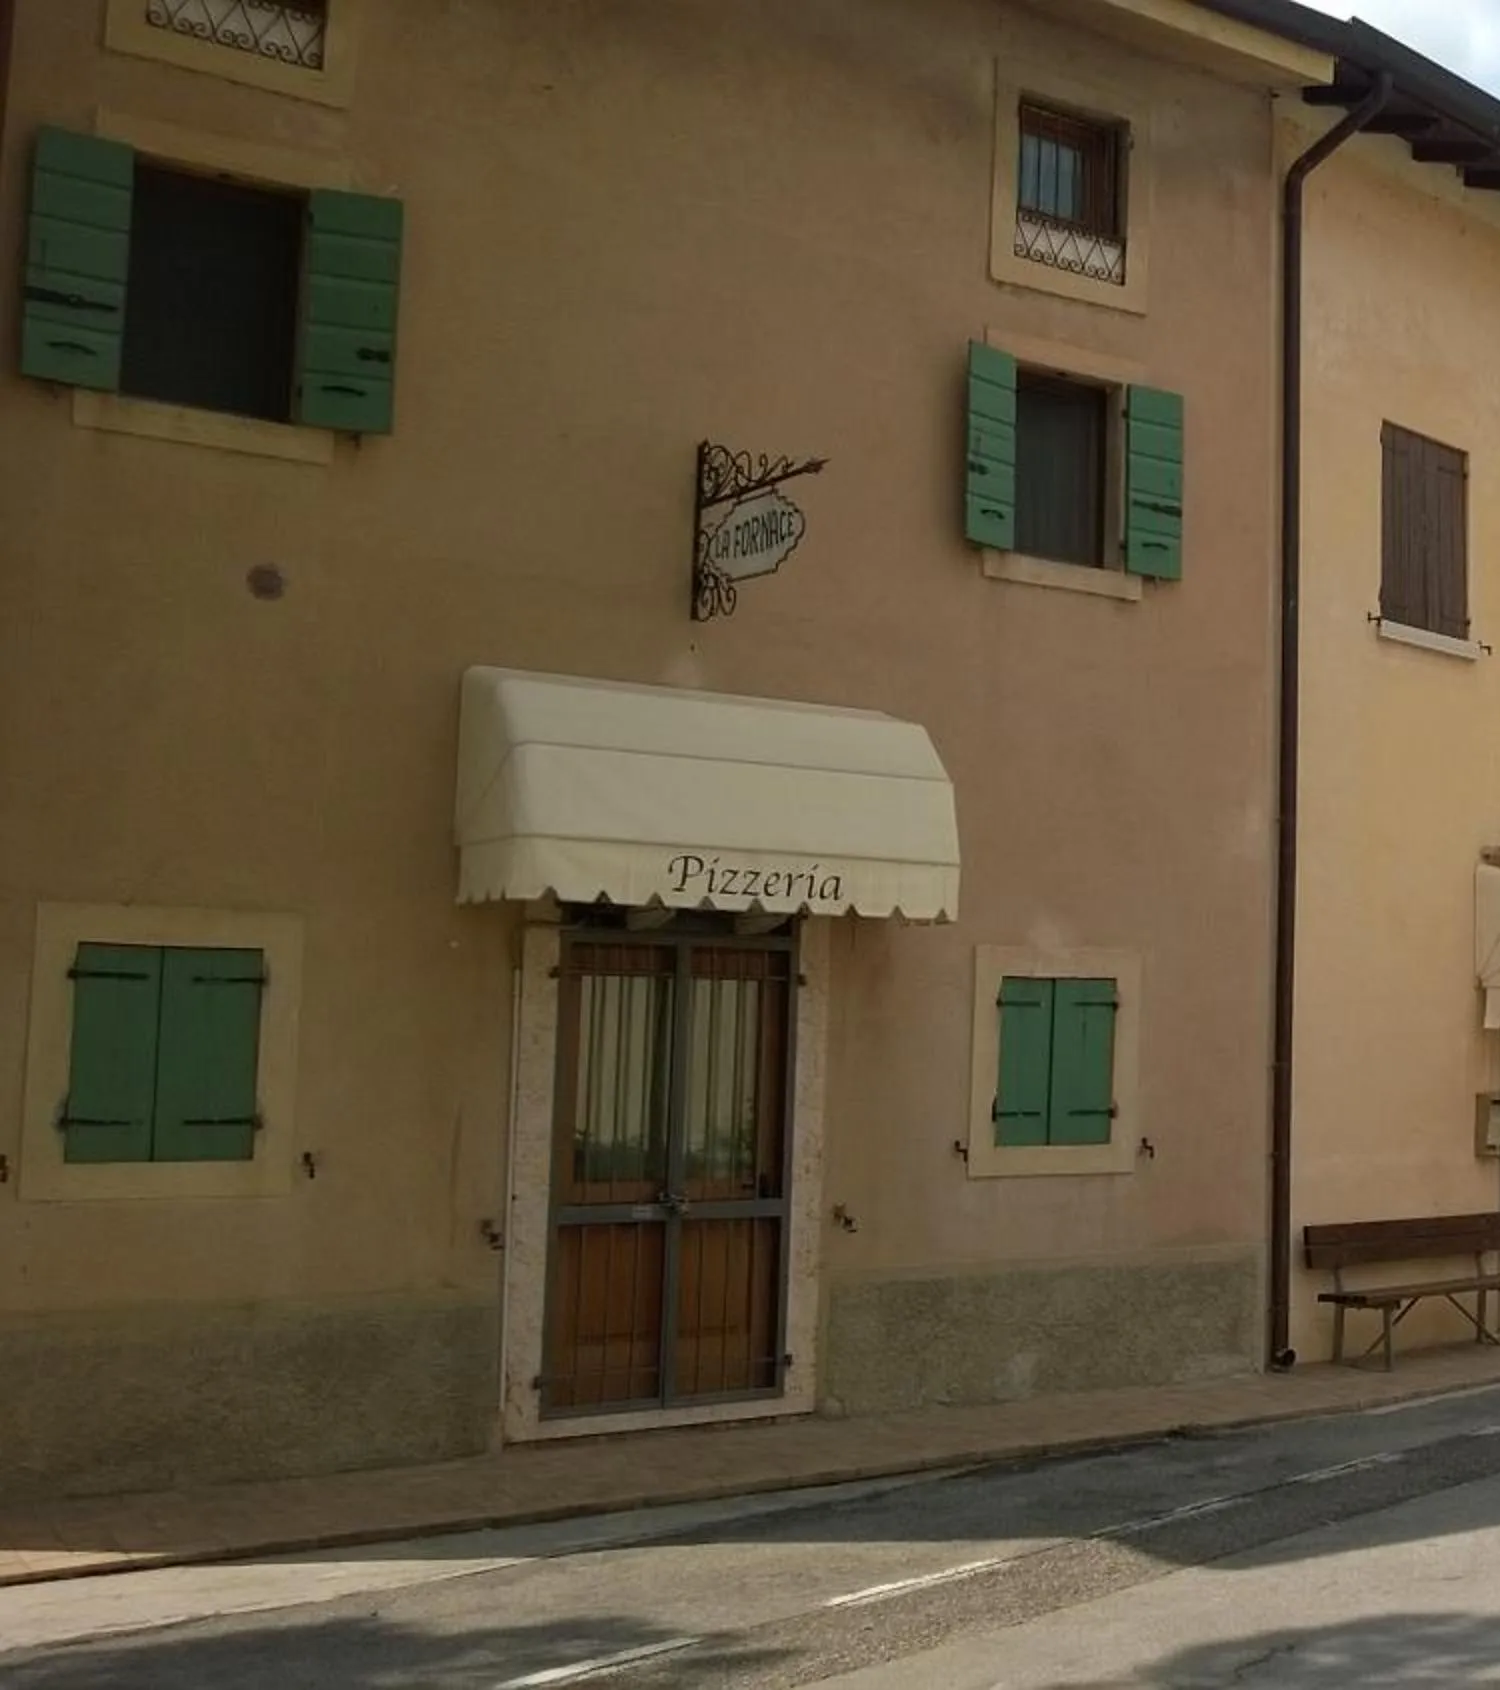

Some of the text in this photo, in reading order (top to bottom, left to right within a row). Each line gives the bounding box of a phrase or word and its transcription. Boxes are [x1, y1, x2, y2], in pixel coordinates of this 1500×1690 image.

[715, 510, 794, 559] LA FORNACE
[668, 854, 842, 900] Pizzeria
